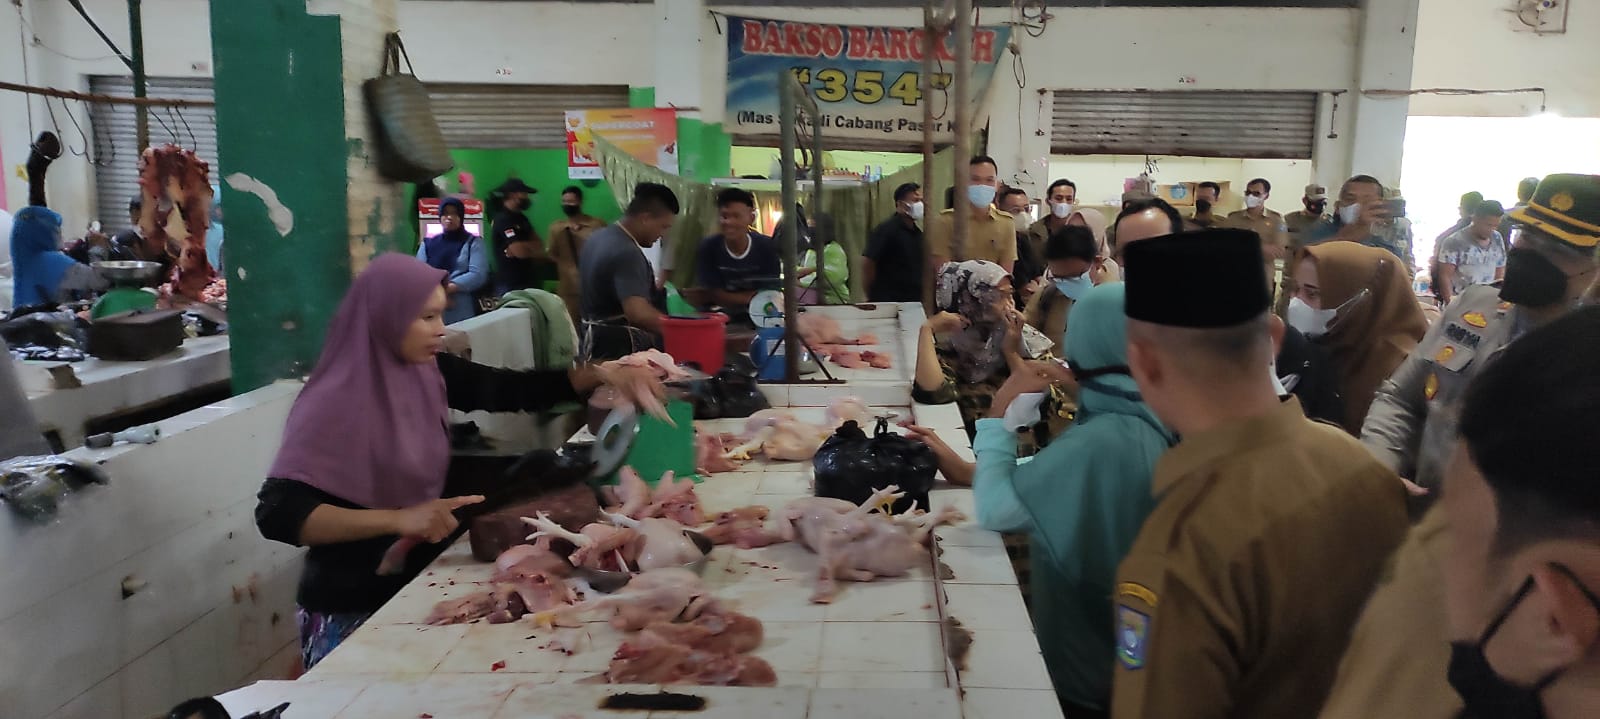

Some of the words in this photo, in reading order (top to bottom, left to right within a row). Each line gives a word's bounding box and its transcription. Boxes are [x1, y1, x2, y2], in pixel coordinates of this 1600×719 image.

[742, 20, 843, 58] BAKSO
[847, 26, 995, 62] BAROKH
[737, 110, 773, 125] (Mas
[834, 115, 893, 133] Cabang
[898, 118, 942, 132] Pasr
